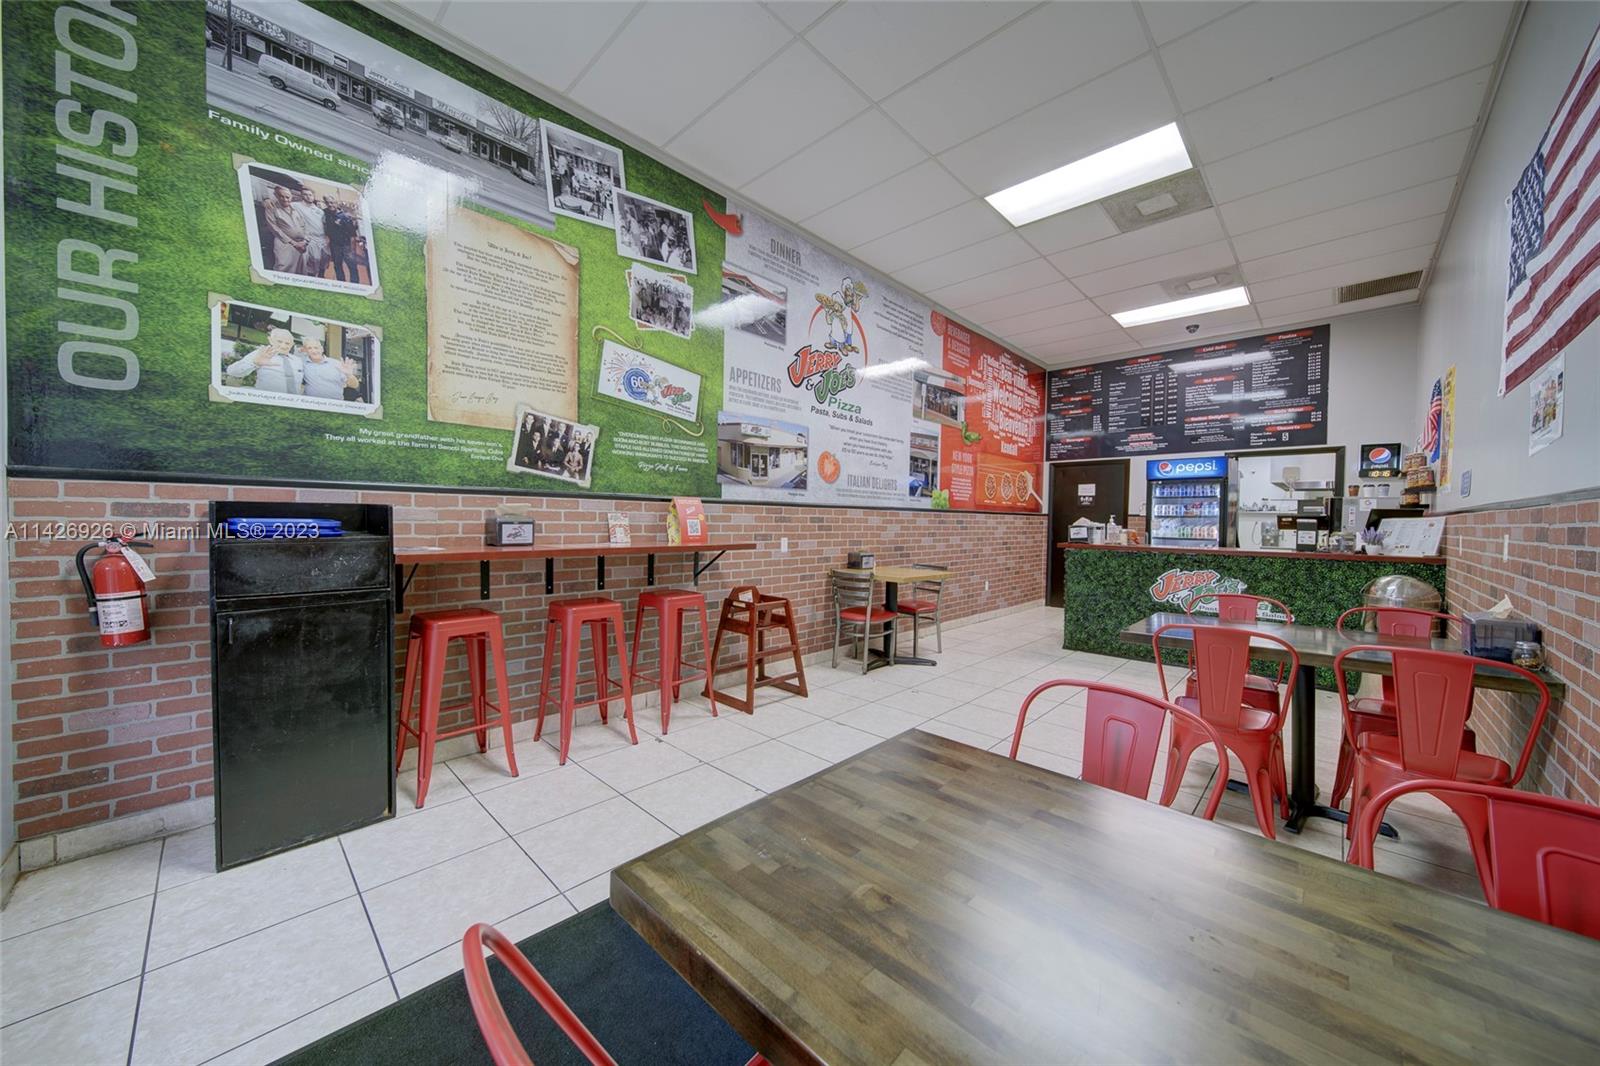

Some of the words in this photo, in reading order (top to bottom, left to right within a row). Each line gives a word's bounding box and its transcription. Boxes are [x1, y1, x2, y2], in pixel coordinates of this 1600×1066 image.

[208, 109, 270, 140] Family
[274, 134, 333, 162] Owned
[338, 159, 373, 177] sinc
[771, 238, 801, 266] DINNER
[57, 238, 140, 391] OUR
[729, 366, 782, 392] APPETIZERS
[806, 378, 814, 391] &
[828, 396, 862, 414] Pizza
[832, 411, 847, 420] Subs
[854, 416, 873, 426] Salads
[325, 434, 345, 442] They
[357, 437, 386, 445] worked
[359, 428, 372, 436] My
[396, 432, 439, 441] grandfather
[1176, 460, 1216, 474] pepsi
[848, 474, 870, 488] ITALIAN
